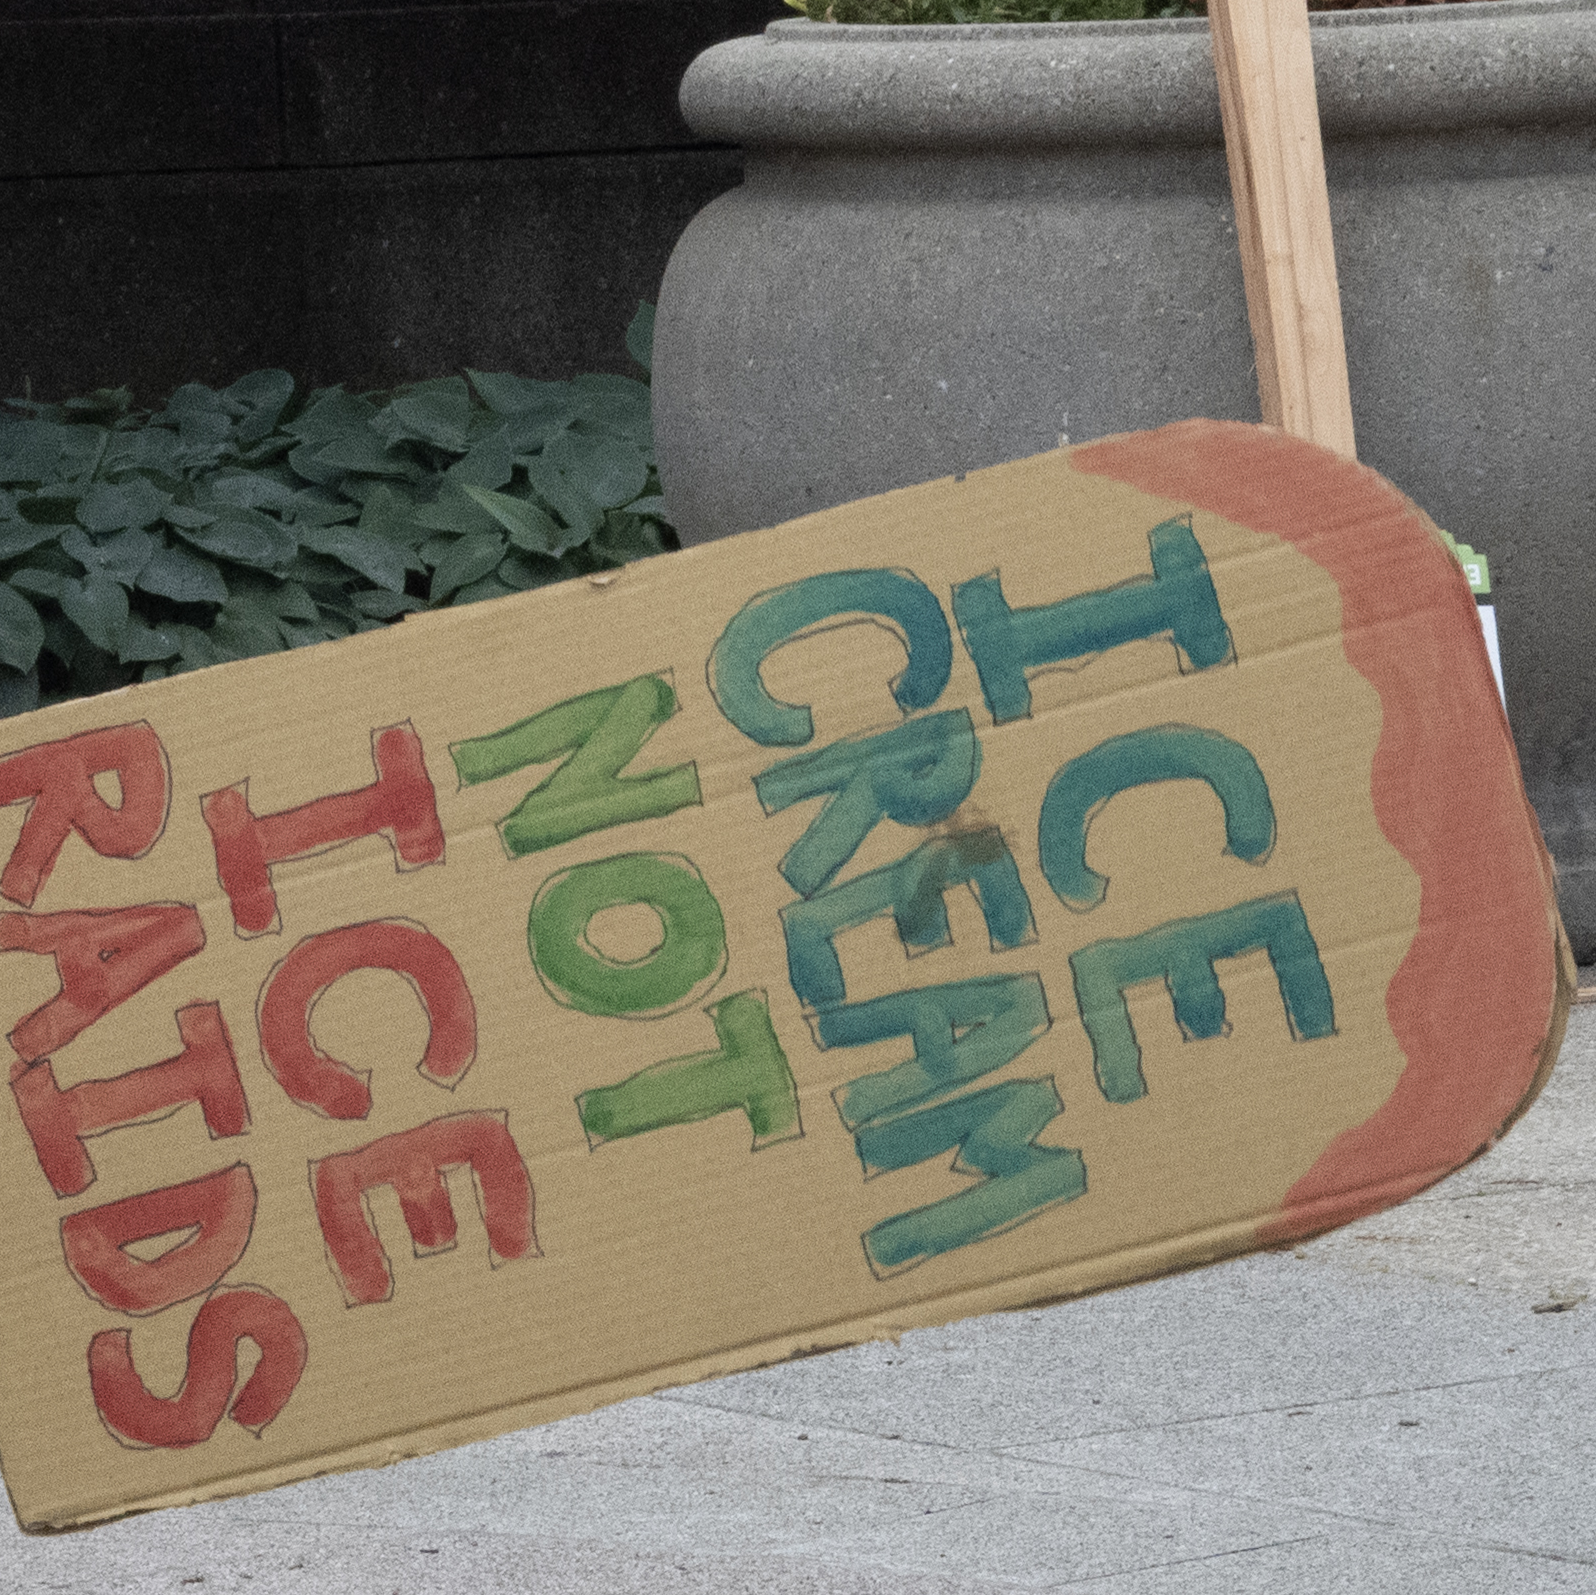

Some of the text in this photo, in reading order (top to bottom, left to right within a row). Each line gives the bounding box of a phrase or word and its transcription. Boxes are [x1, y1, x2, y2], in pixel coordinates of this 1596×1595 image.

[200, 719, 543, 1310] ICE
[451, 668, 807, 1153] NOT
[705, 566, 1088, 1284] CREAM
[951, 513, 1339, 1106] ICE
